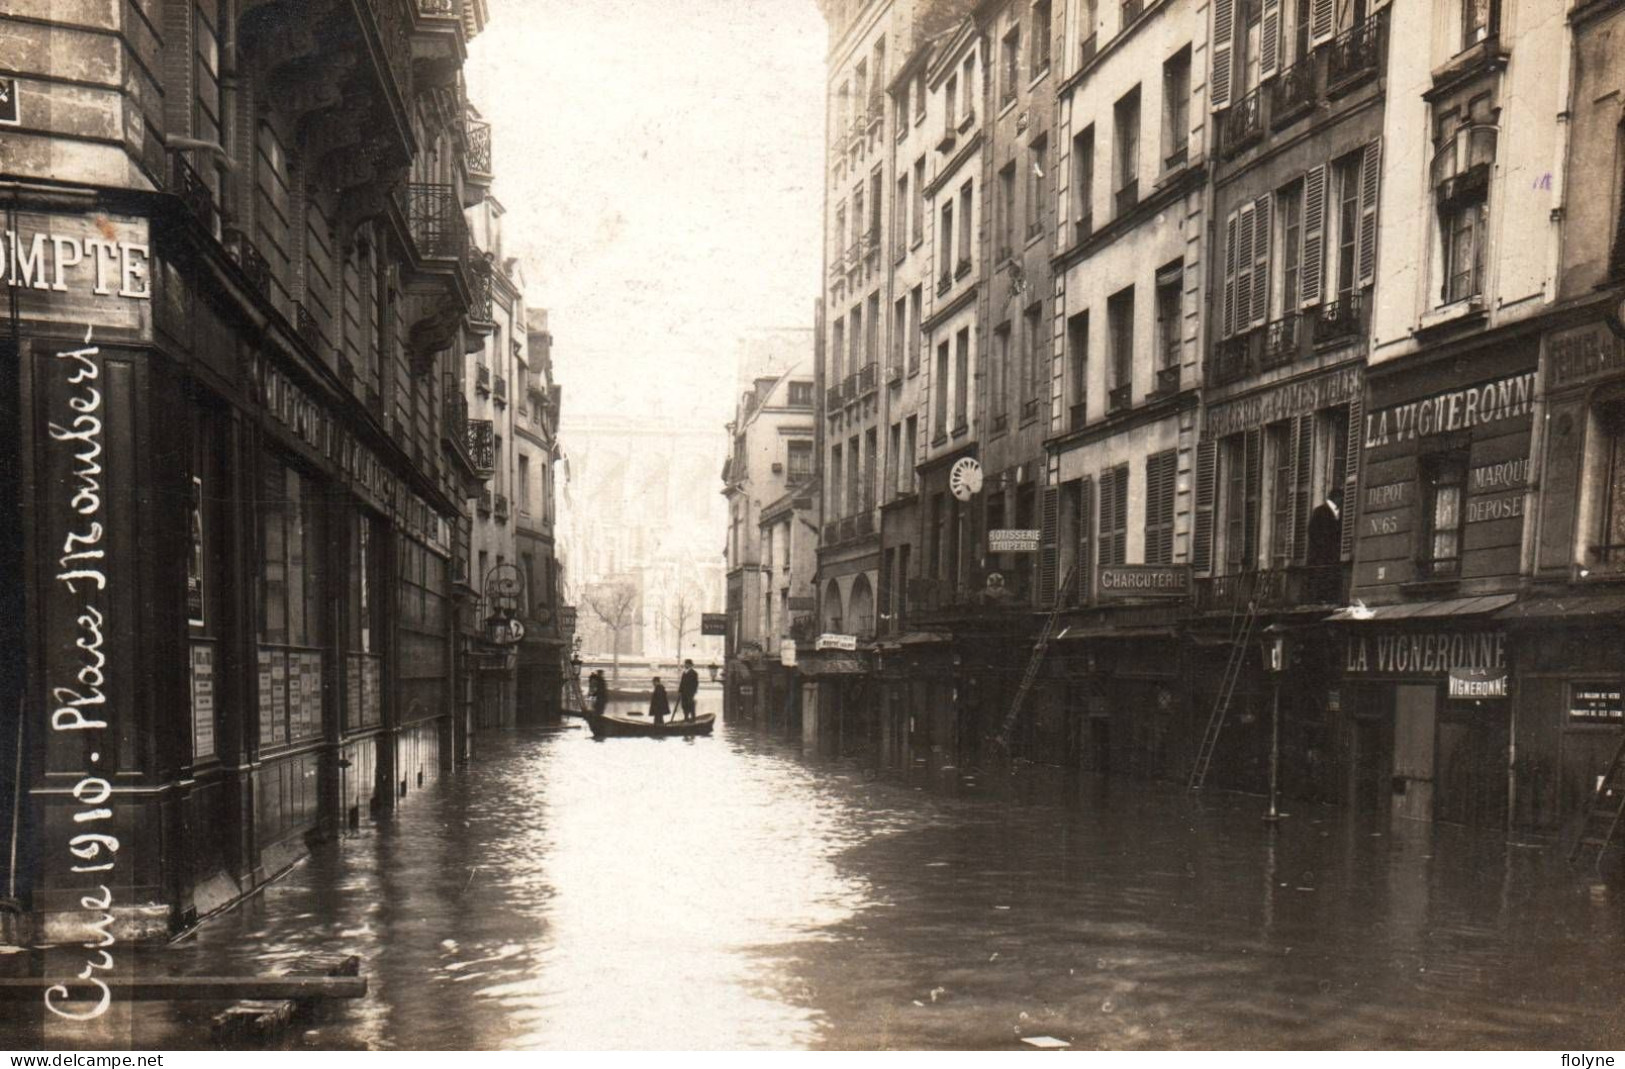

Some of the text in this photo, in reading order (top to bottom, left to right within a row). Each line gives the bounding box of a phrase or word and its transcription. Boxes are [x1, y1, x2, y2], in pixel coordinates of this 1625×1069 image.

[0, 231, 151, 298] MPTE
[1365, 411, 1389, 448] LA
[991, 541, 1037, 551] TRIPERIE
[1102, 571, 1186, 588] CHARCUTERIE
[52, 607, 107, 731] Place
[1346, 632, 1507, 672] LA VIGNERONNE
[1449, 675, 1508, 696] VIGNERONNE
[1470, 668, 1487, 676] LA
[45, 885, 115, 1020] Crue
